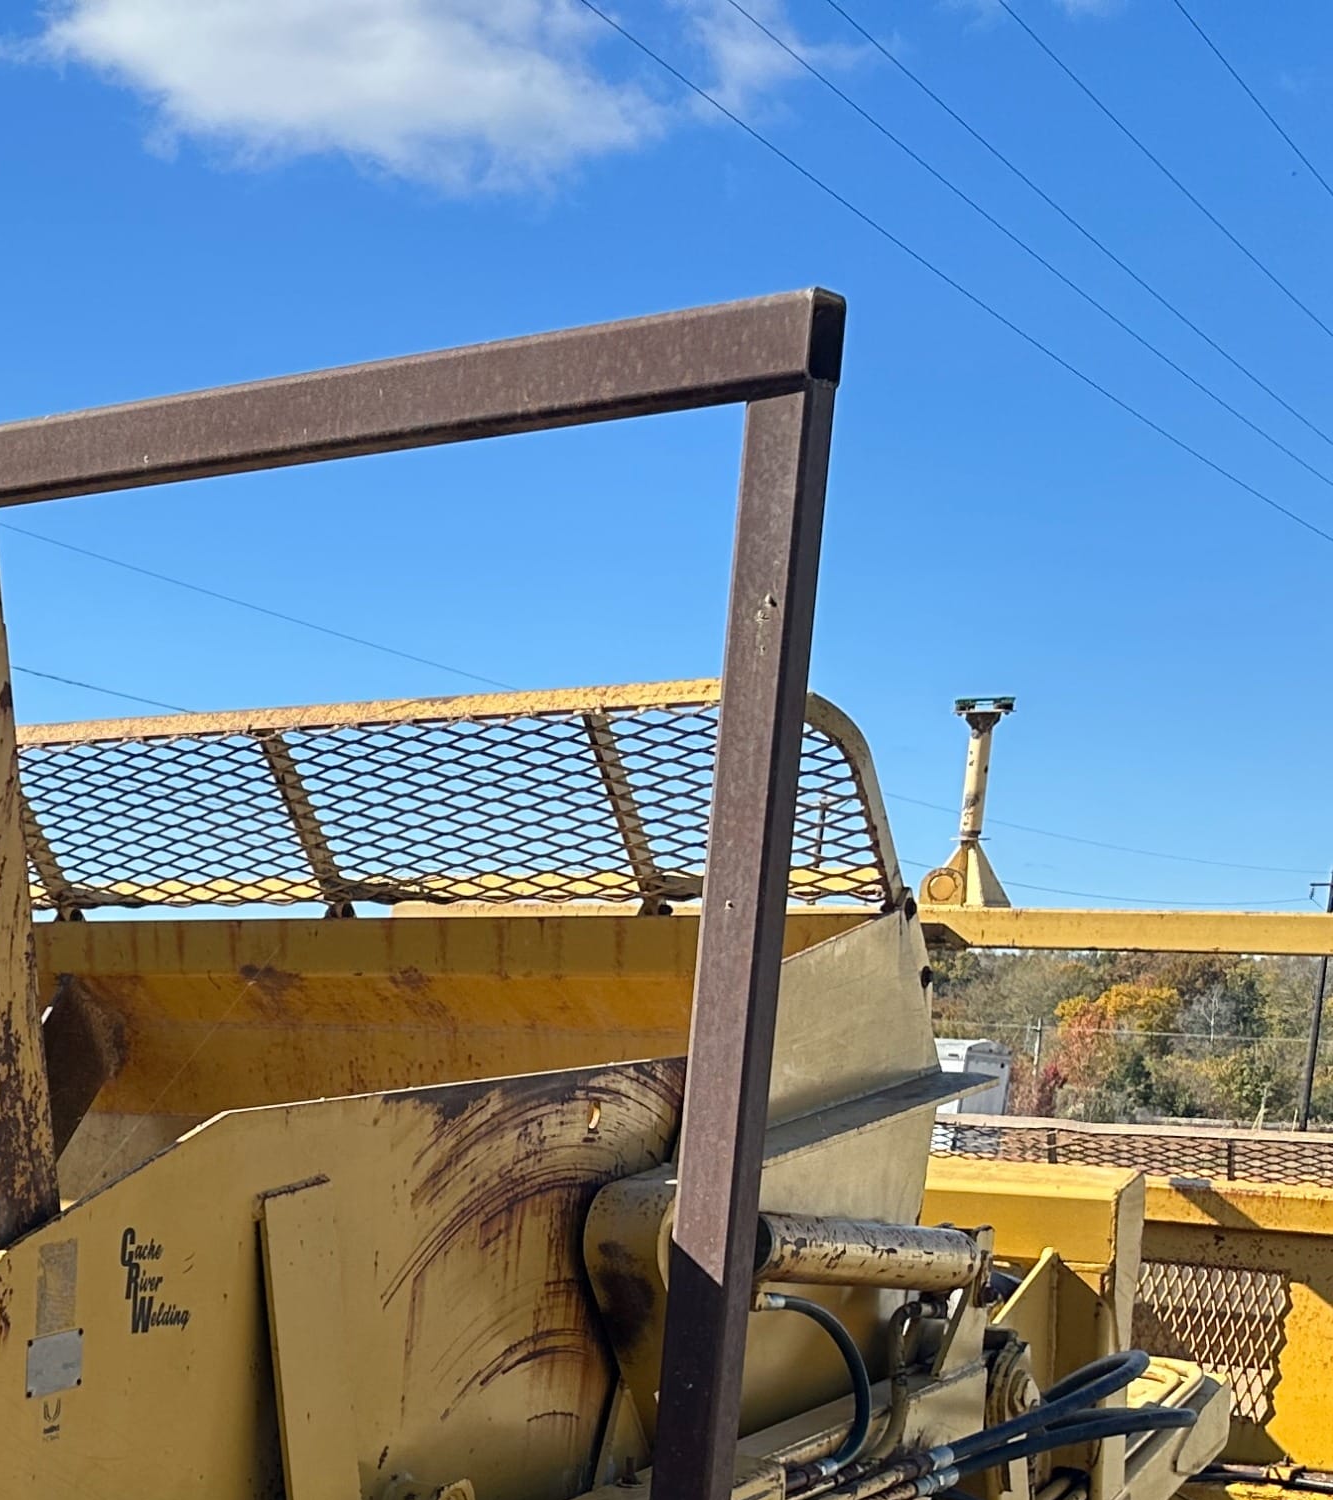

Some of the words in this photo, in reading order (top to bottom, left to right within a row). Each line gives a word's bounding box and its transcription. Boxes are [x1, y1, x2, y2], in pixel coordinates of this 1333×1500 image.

[121, 1227, 164, 1267] Cache
[125, 1262, 164, 1300] River
[131, 1295, 191, 1334] Welding
